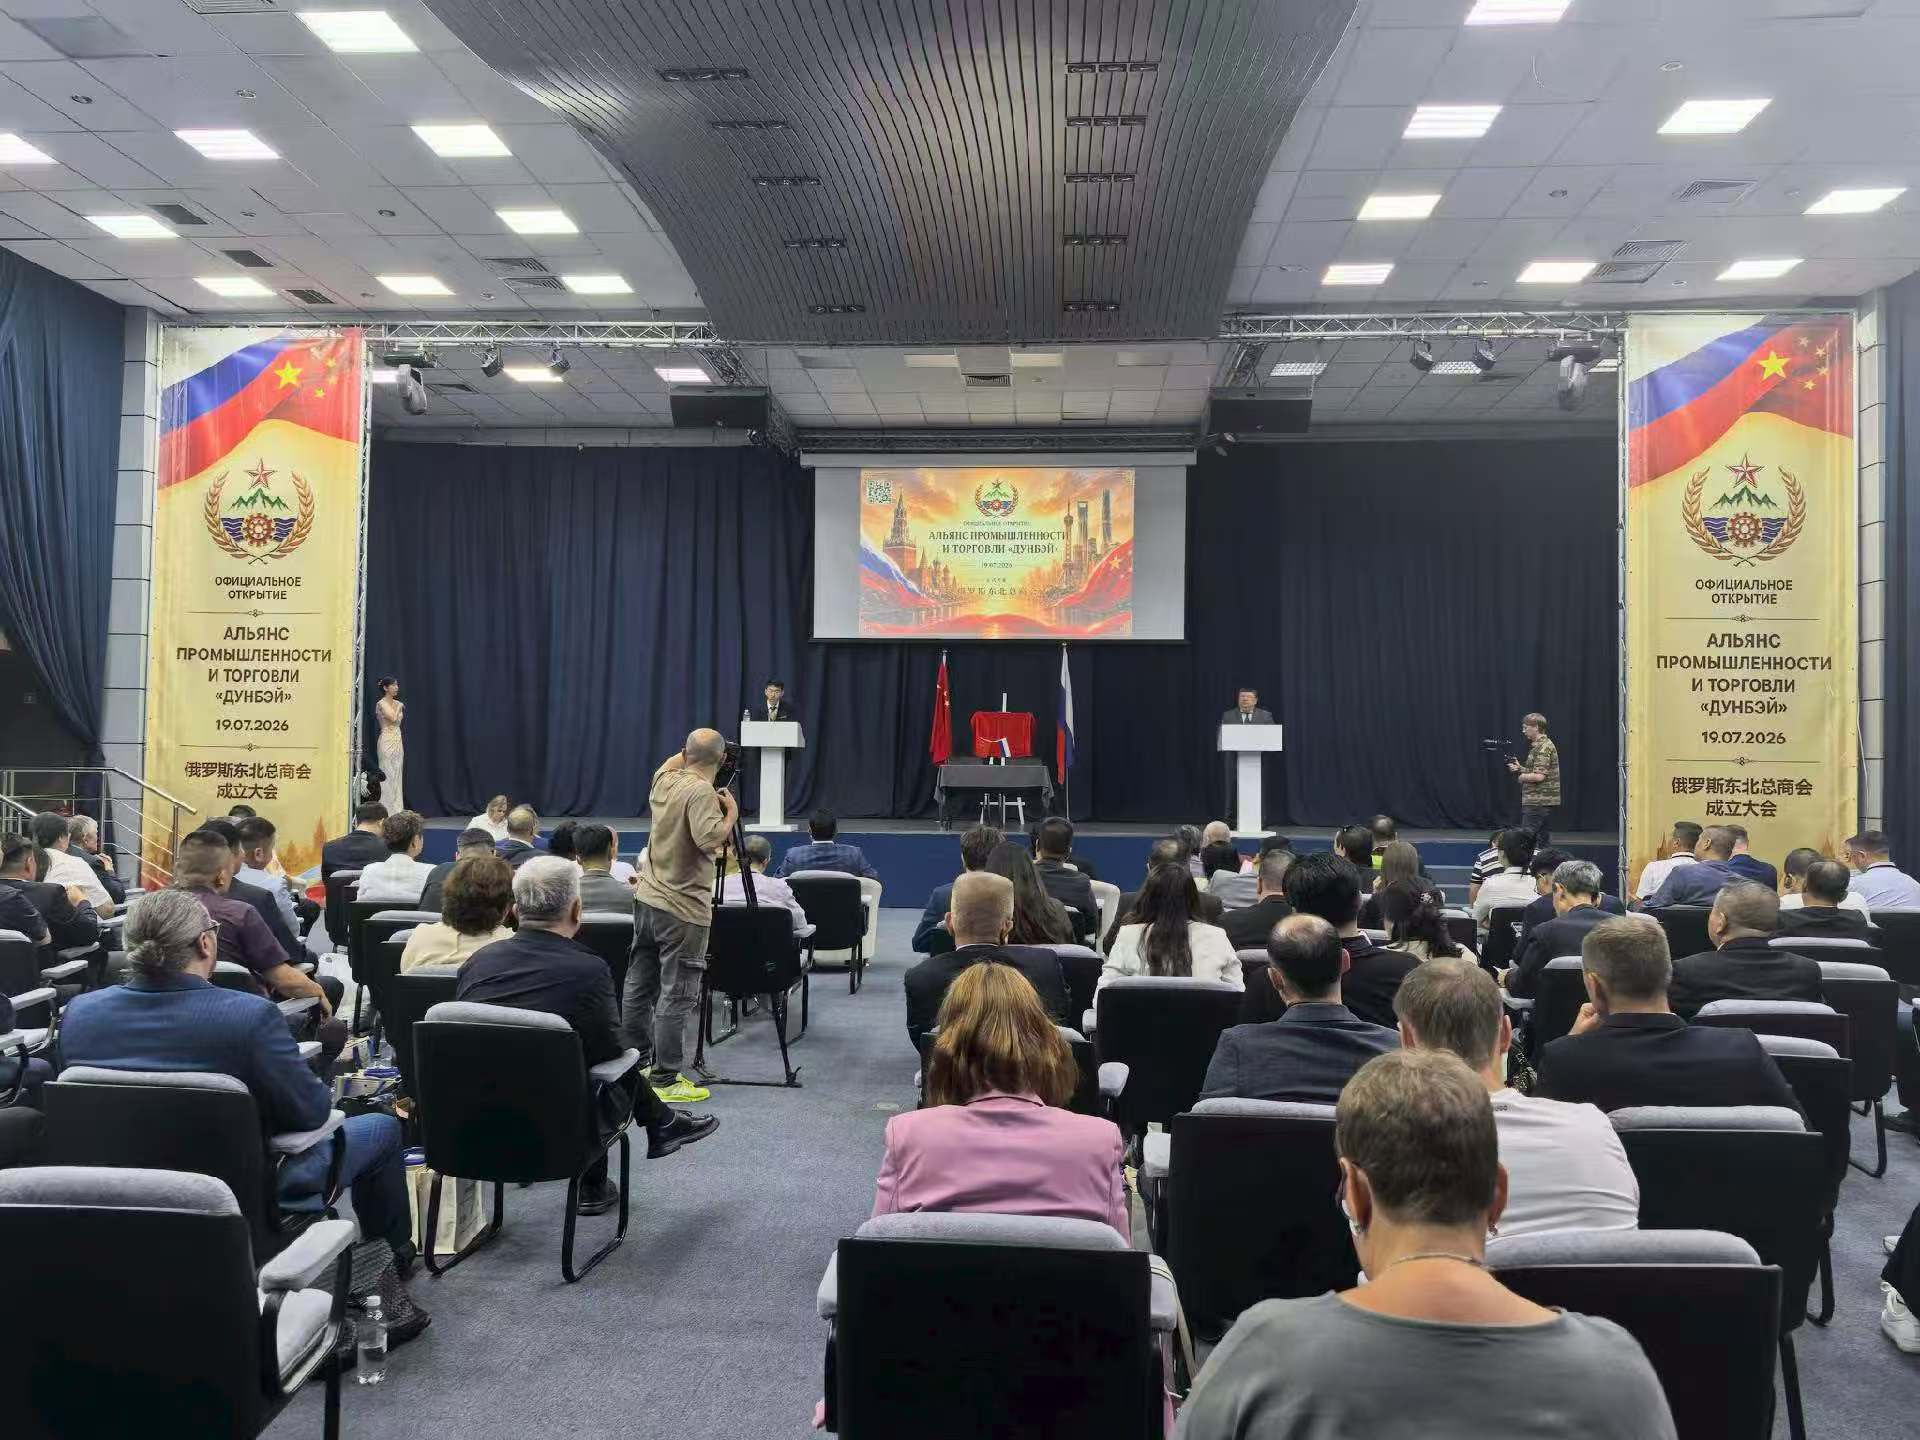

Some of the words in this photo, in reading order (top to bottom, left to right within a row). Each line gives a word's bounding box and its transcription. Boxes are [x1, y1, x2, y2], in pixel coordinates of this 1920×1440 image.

[928, 531, 969, 541] АЛЬЯНС
[970, 531, 1069, 541] ПРОМЫШЛЕННОСТИ
[942, 544, 950, 554] И
[951, 544, 1005, 554] ТОРГОВЛИ
[215, 576, 301, 589] ОФИЦИАЛЬНОЕ
[1695, 579, 1793, 592] ОФИЦИАЛЬНОЕ
[228, 590, 287, 600] ОТКРЫТИЕ
[1711, 593, 1778, 605] ОТКРЫТИЕ
[223, 627, 289, 641] АЛЬЯНС
[1706, 633, 1781, 649] АЛЬЯНС
[176, 647, 332, 662] ПРОМЫШЛЕННОСТИ
[1656, 655, 1832, 670] ПРОМЫШЛЕННОСТИ
[208, 669, 218, 682] И
[223, 669, 299, 683] ТОРГОВЛИ
[1692, 678, 1702, 692] И
[1708, 678, 1795, 693] ТОРГОВЛИ
[215, 687, 292, 705] «ДУНБЭЙ»
[1700, 697, 1788, 716] «ДУНБЭЙ»
[216, 719, 289, 732] 19.07.2026
[1701, 731, 1786, 745] 19.07.2026
[185, 762, 312, 780] 俄罗斯东北总商会
[216, 783, 278, 800] 成立大会
[1671, 777, 1813, 796] 俄罗斯东北总商会
[1705, 800, 1777, 818] 成立大会
